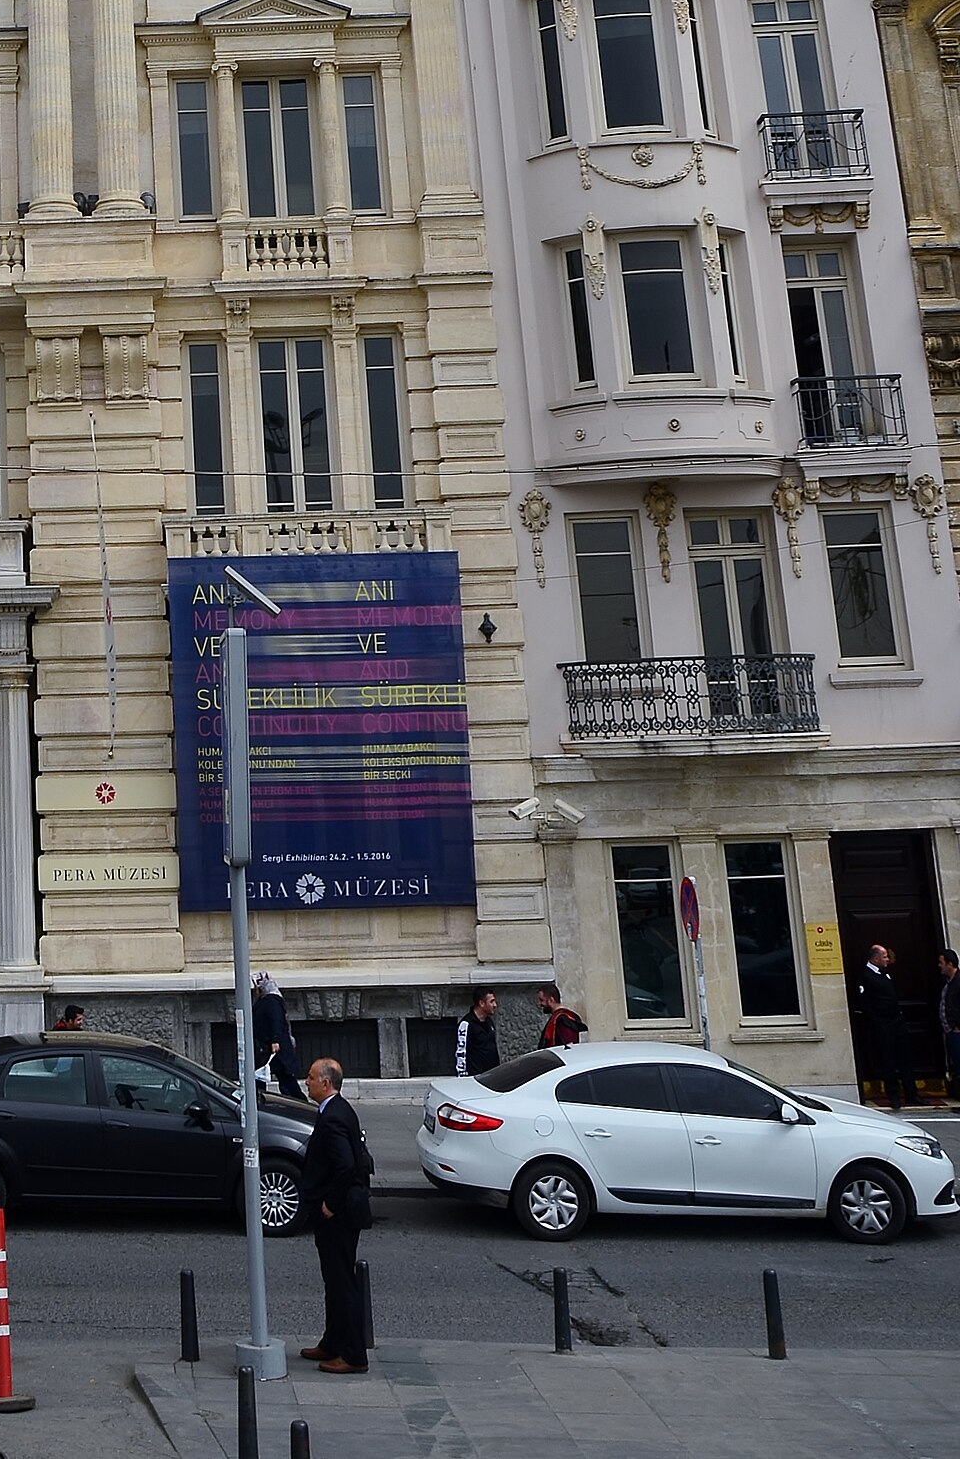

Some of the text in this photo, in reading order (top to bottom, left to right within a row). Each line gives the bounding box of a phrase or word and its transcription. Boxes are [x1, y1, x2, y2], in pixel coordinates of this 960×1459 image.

[192, 580, 395, 605] AN ANI
[357, 605, 458, 627] MEMORY
[193, 633, 387, 657] VE VE
[195, 659, 409, 683] AN AND
[362, 745, 392, 754] HUMA
[198, 771, 215, 782] BİR
[363, 769, 380, 780] BİR
[262, 854, 283, 863] Sergi
[285, 854, 327, 862] Exhibition:
[329, 853, 349, 861] 24.2.
[356, 852, 391, 860] 1.5.2016
[53, 865, 167, 882] PERA MÜZESİ
[227, 875, 430, 898] ERA MÜZESİ
